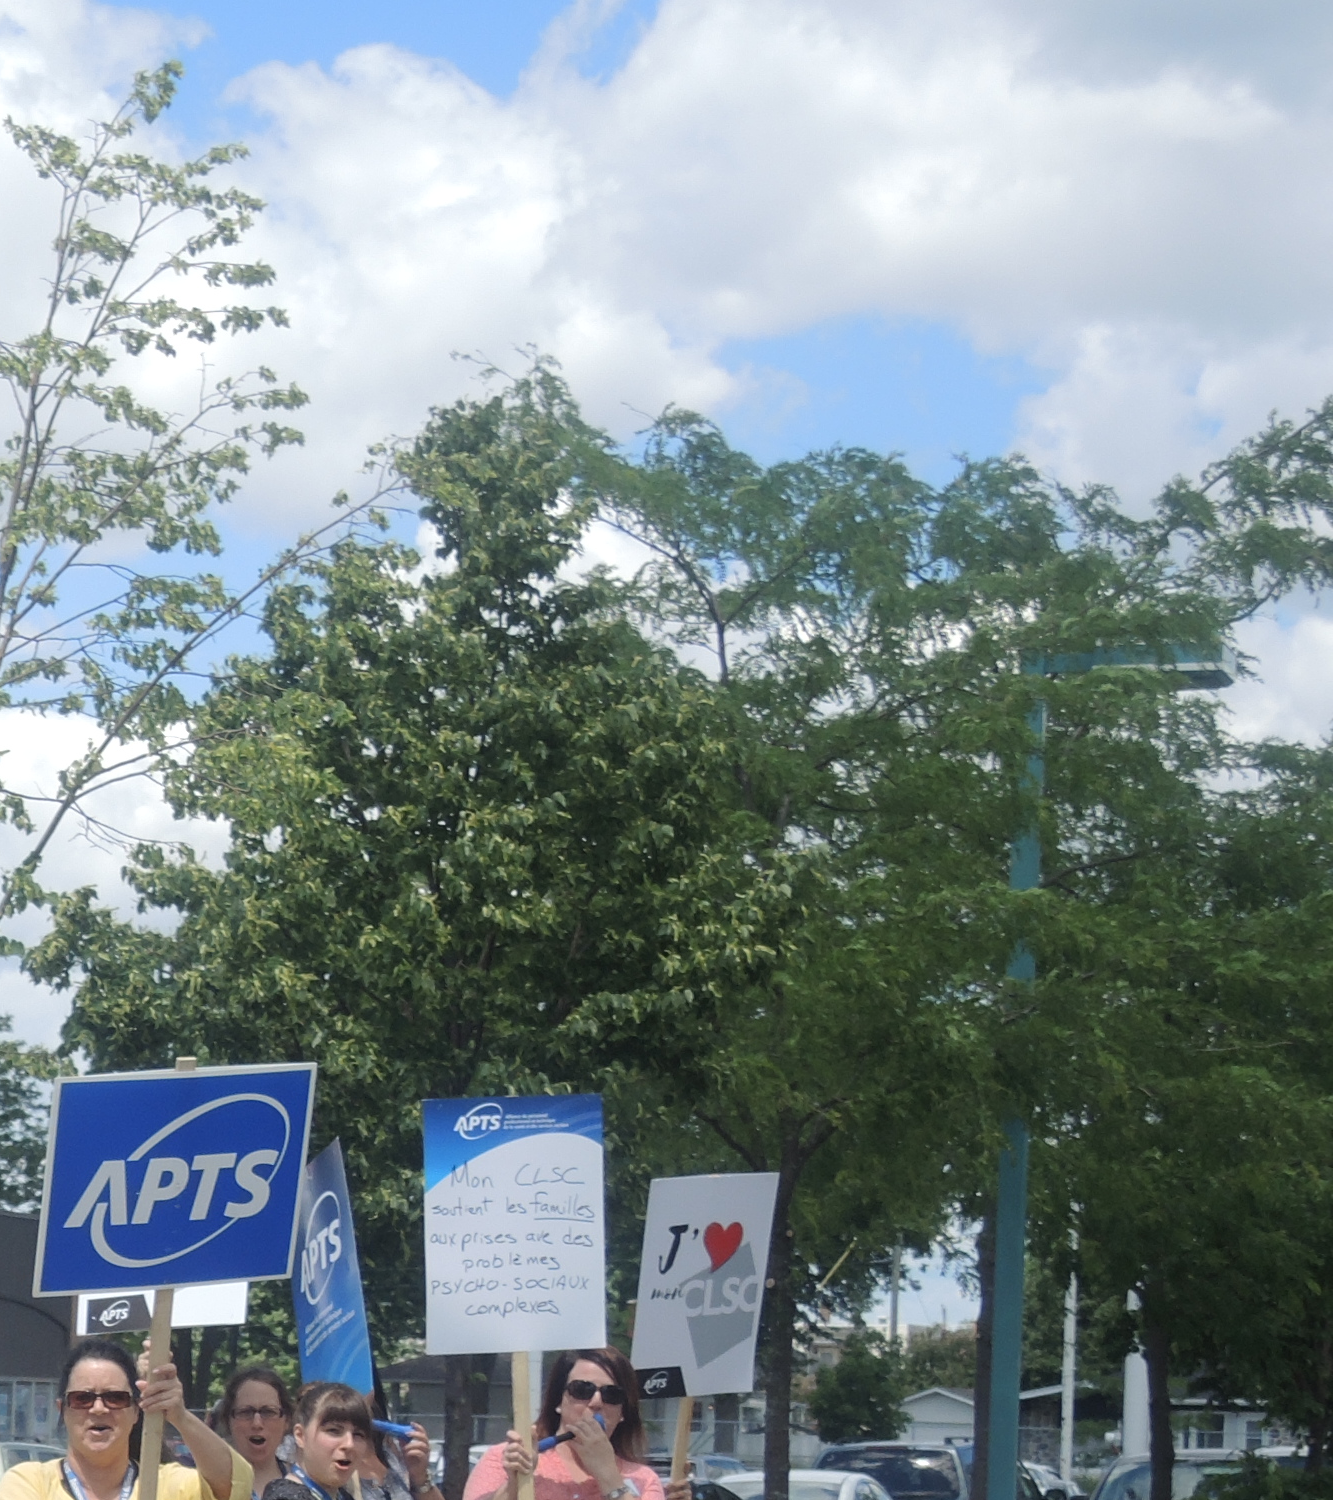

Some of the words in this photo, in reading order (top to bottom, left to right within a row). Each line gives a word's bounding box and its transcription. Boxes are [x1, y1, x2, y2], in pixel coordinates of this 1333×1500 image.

[453, 1115, 502, 1132] APTS
[451, 1160, 494, 1188] Mon
[514, 1163, 585, 1187] CLSC
[63, 1148, 280, 1230] APTS
[504, 1196, 527, 1214] les
[529, 1191, 595, 1219] familles
[430, 1232, 456, 1246] aux
[461, 1232, 517, 1252] prises
[562, 1227, 594, 1247] des
[301, 1218, 342, 1293] APTS
[462, 1251, 561, 1273] problèmes
[464, 1297, 562, 1318] complexes
[680, 1274, 760, 1318] CLSC
[99, 1308, 130, 1322] APTS
[643, 1378, 668, 1390] APTS
